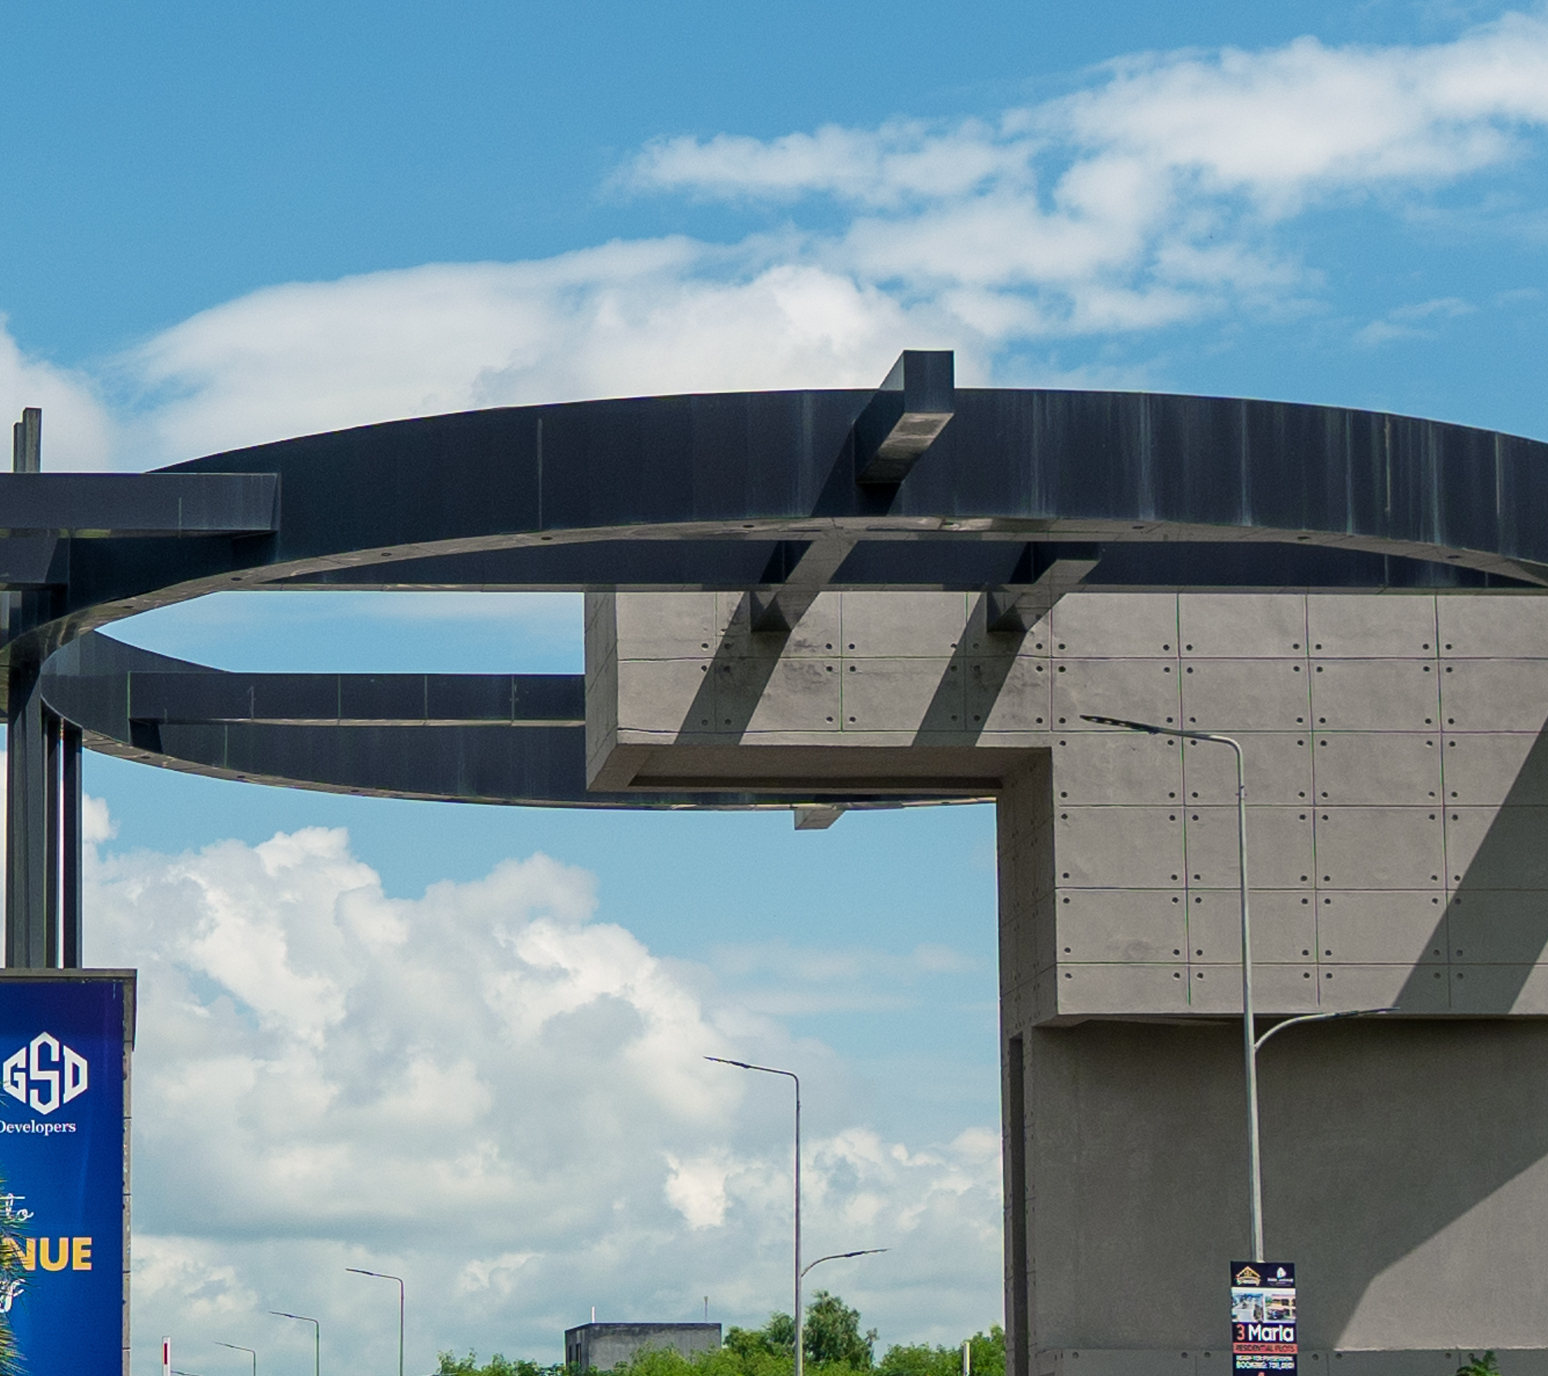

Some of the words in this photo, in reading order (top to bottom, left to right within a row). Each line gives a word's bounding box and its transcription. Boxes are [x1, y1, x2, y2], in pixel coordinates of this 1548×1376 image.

[2, 1031, 89, 1116] GSD
[1236, 1323, 1246, 1341] 3
[1248, 1323, 1294, 1342] Marla
